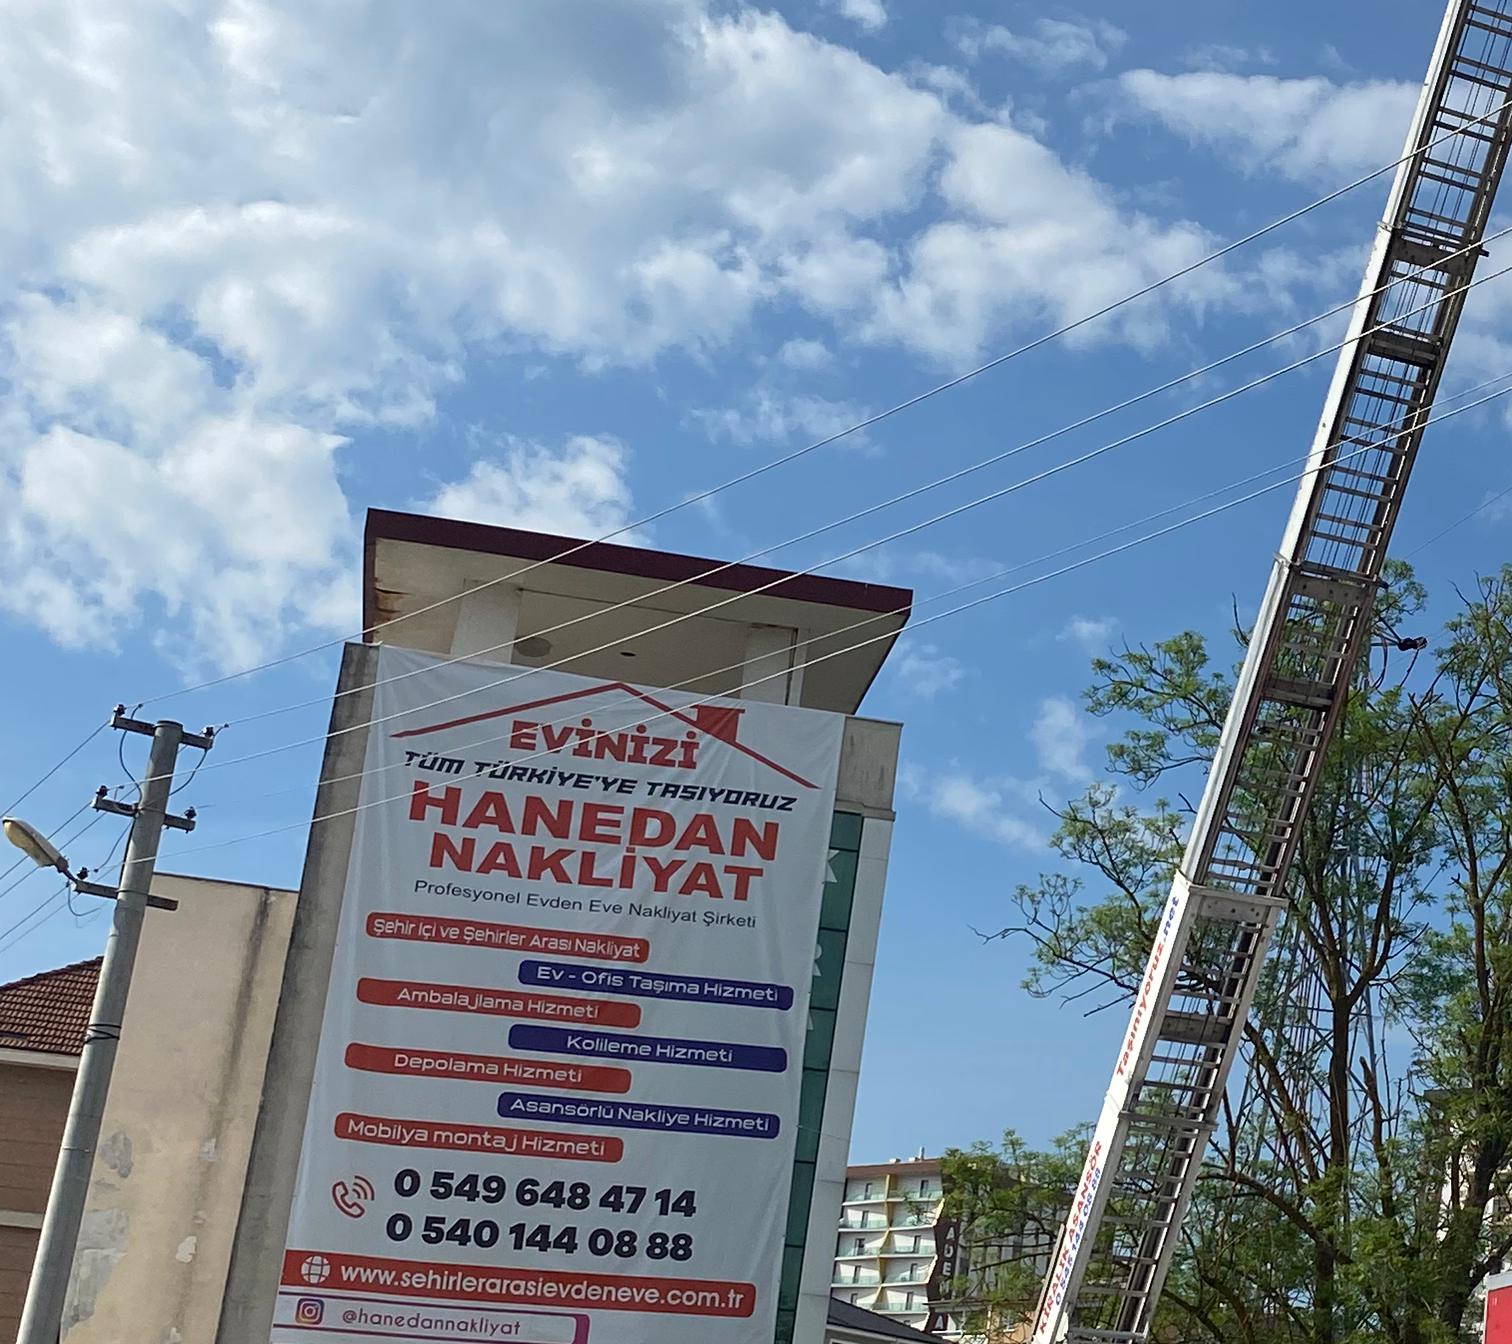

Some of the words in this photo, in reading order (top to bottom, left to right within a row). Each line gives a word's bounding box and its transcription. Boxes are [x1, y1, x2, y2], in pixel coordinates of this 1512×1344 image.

[510, 718, 700, 770] EVİNİZİ
[404, 751, 465, 775] TÜM
[474, 761, 638, 794] TÜRKİYE'YE
[409, 780, 780, 861] HANEDAN
[429, 832, 764, 901] NAKLİYAT
[414, 880, 520, 904] Profesyonel
[527, 893, 582, 911] Evden
[589, 899, 623, 914] Eve
[629, 902, 697, 923] Nakliyat
[702, 910, 756, 928] Şirketi
[373, 918, 415, 937] Şehir
[440, 925, 460, 939] ve
[463, 926, 526, 947] Şehirler
[529, 934, 572, 952] Arası
[574, 938, 642, 959] Nakliyat
[397, 987, 525, 1012] Ambalajlama
[527, 999, 599, 1019] Hizmeti
[536, 966, 565, 981] Ev
[581, 971, 624, 987] Ofis
[628, 974, 700, 995] Taşıma
[703, 981, 779, 1002] Hizmeti
[394, 1054, 499, 1076] Depolama
[503, 1062, 583, 1083] Hizmeti
[566, 1035, 652, 1056] Kolileme
[655, 1043, 733, 1063] Hizmeti
[510, 1098, 614, 1120] Asansörlü
[617, 1106, 690, 1127] Nakliye
[694, 1112, 770, 1132] Hizmeti
[347, 1118, 429, 1143] Mobilya
[433, 1130, 518, 1152] montaj
[521, 1136, 606, 1156] Hizmeti
[393, 1168, 421, 1197] 0
[429, 1170, 506, 1204] 549
[515, 1177, 591, 1211] 648
[598, 1184, 647, 1214] 47
[654, 1188, 697, 1217] 14
[386, 1212, 413, 1242] 0
[421, 1215, 500, 1249] 540
[508, 1222, 579, 1254] 144
[588, 1227, 638, 1258] 08
[646, 1231, 693, 1261] 88
[341, 1264, 744, 1309] www.sehirlerarasievdeneve.com.tr
[342, 1307, 521, 1337] @hanedannakliyat
